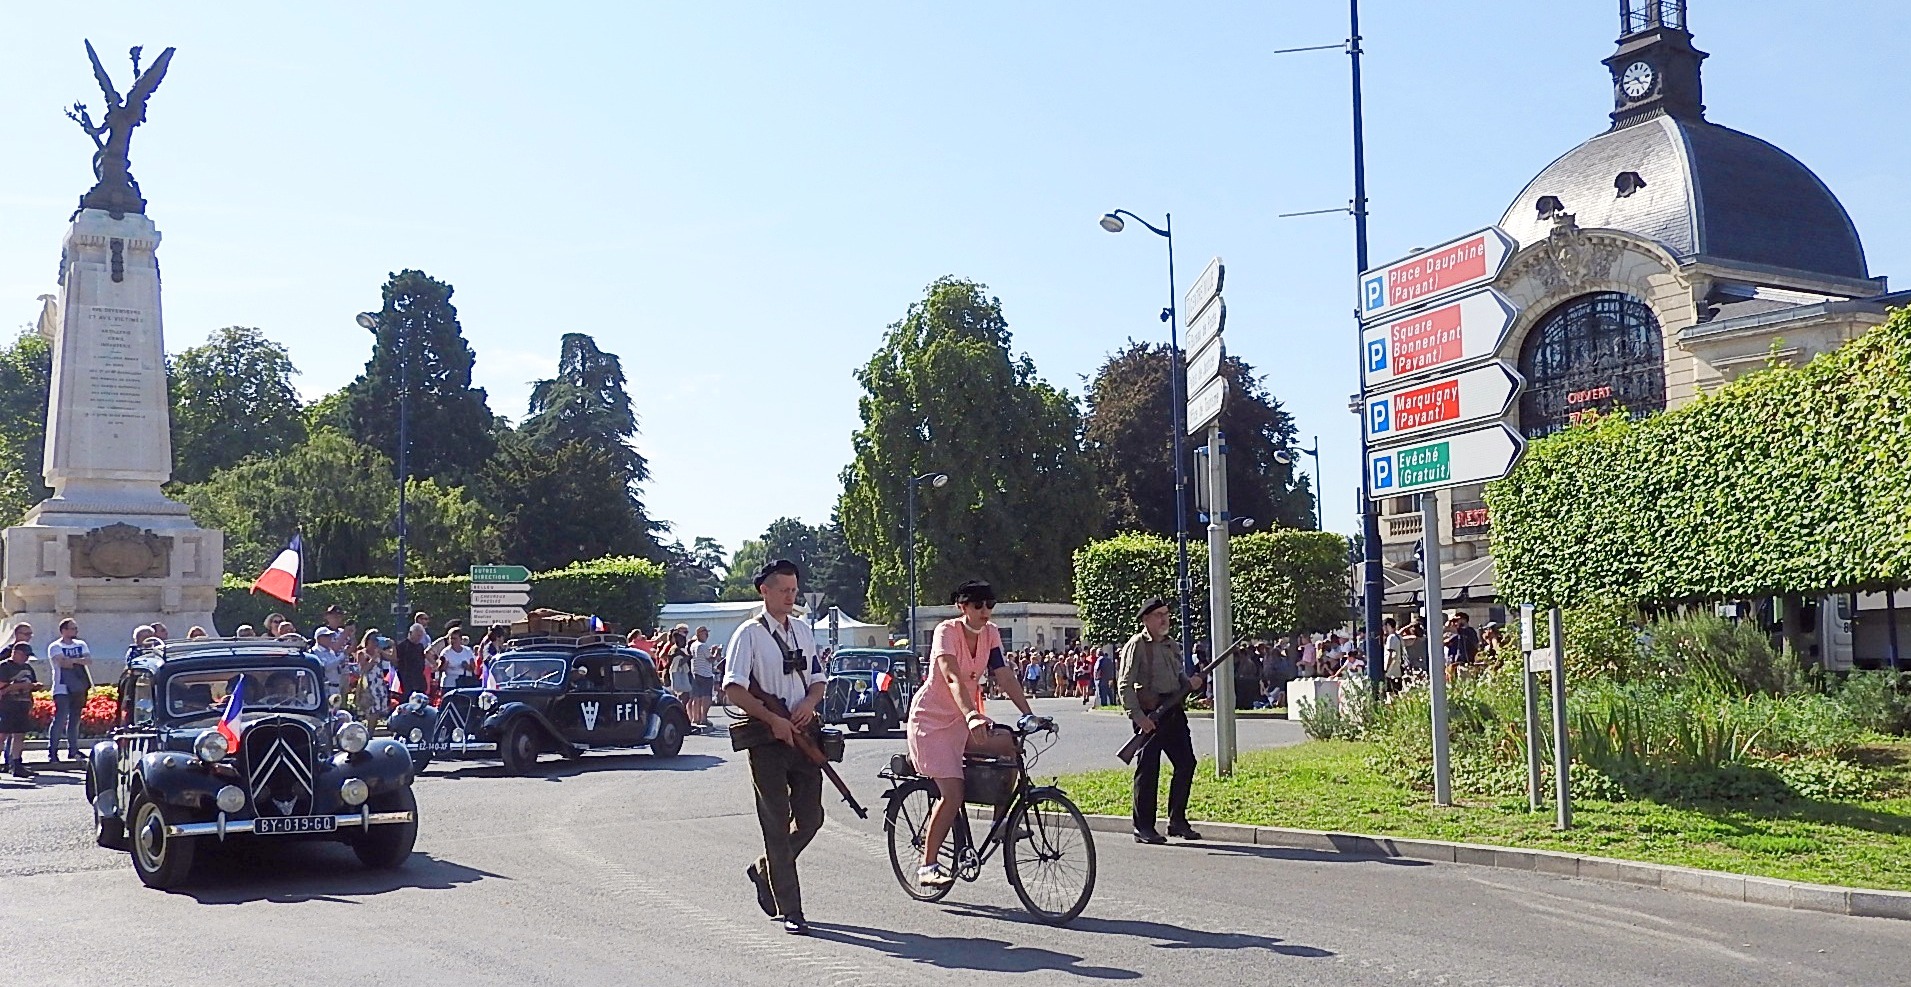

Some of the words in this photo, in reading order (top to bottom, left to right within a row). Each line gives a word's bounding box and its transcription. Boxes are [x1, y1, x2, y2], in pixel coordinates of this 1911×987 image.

[1390, 266, 1420, 285] Place
[1426, 243, 1485, 273] Dauphine
[1391, 273, 1439, 304] (Payant)
[1393, 318, 1433, 343] Square
[1393, 325, 1462, 357] Bonnenfant
[1394, 346, 1443, 376] (Payant)
[1396, 384, 1459, 412] Marquigny
[1567, 386, 1610, 404] OUVERT
[1396, 402, 1445, 430] (Payant)
[1399, 447, 1439, 469] Evêché
[1399, 461, 1451, 487] (Gratuit)
[1455, 508, 1488, 529] REST
